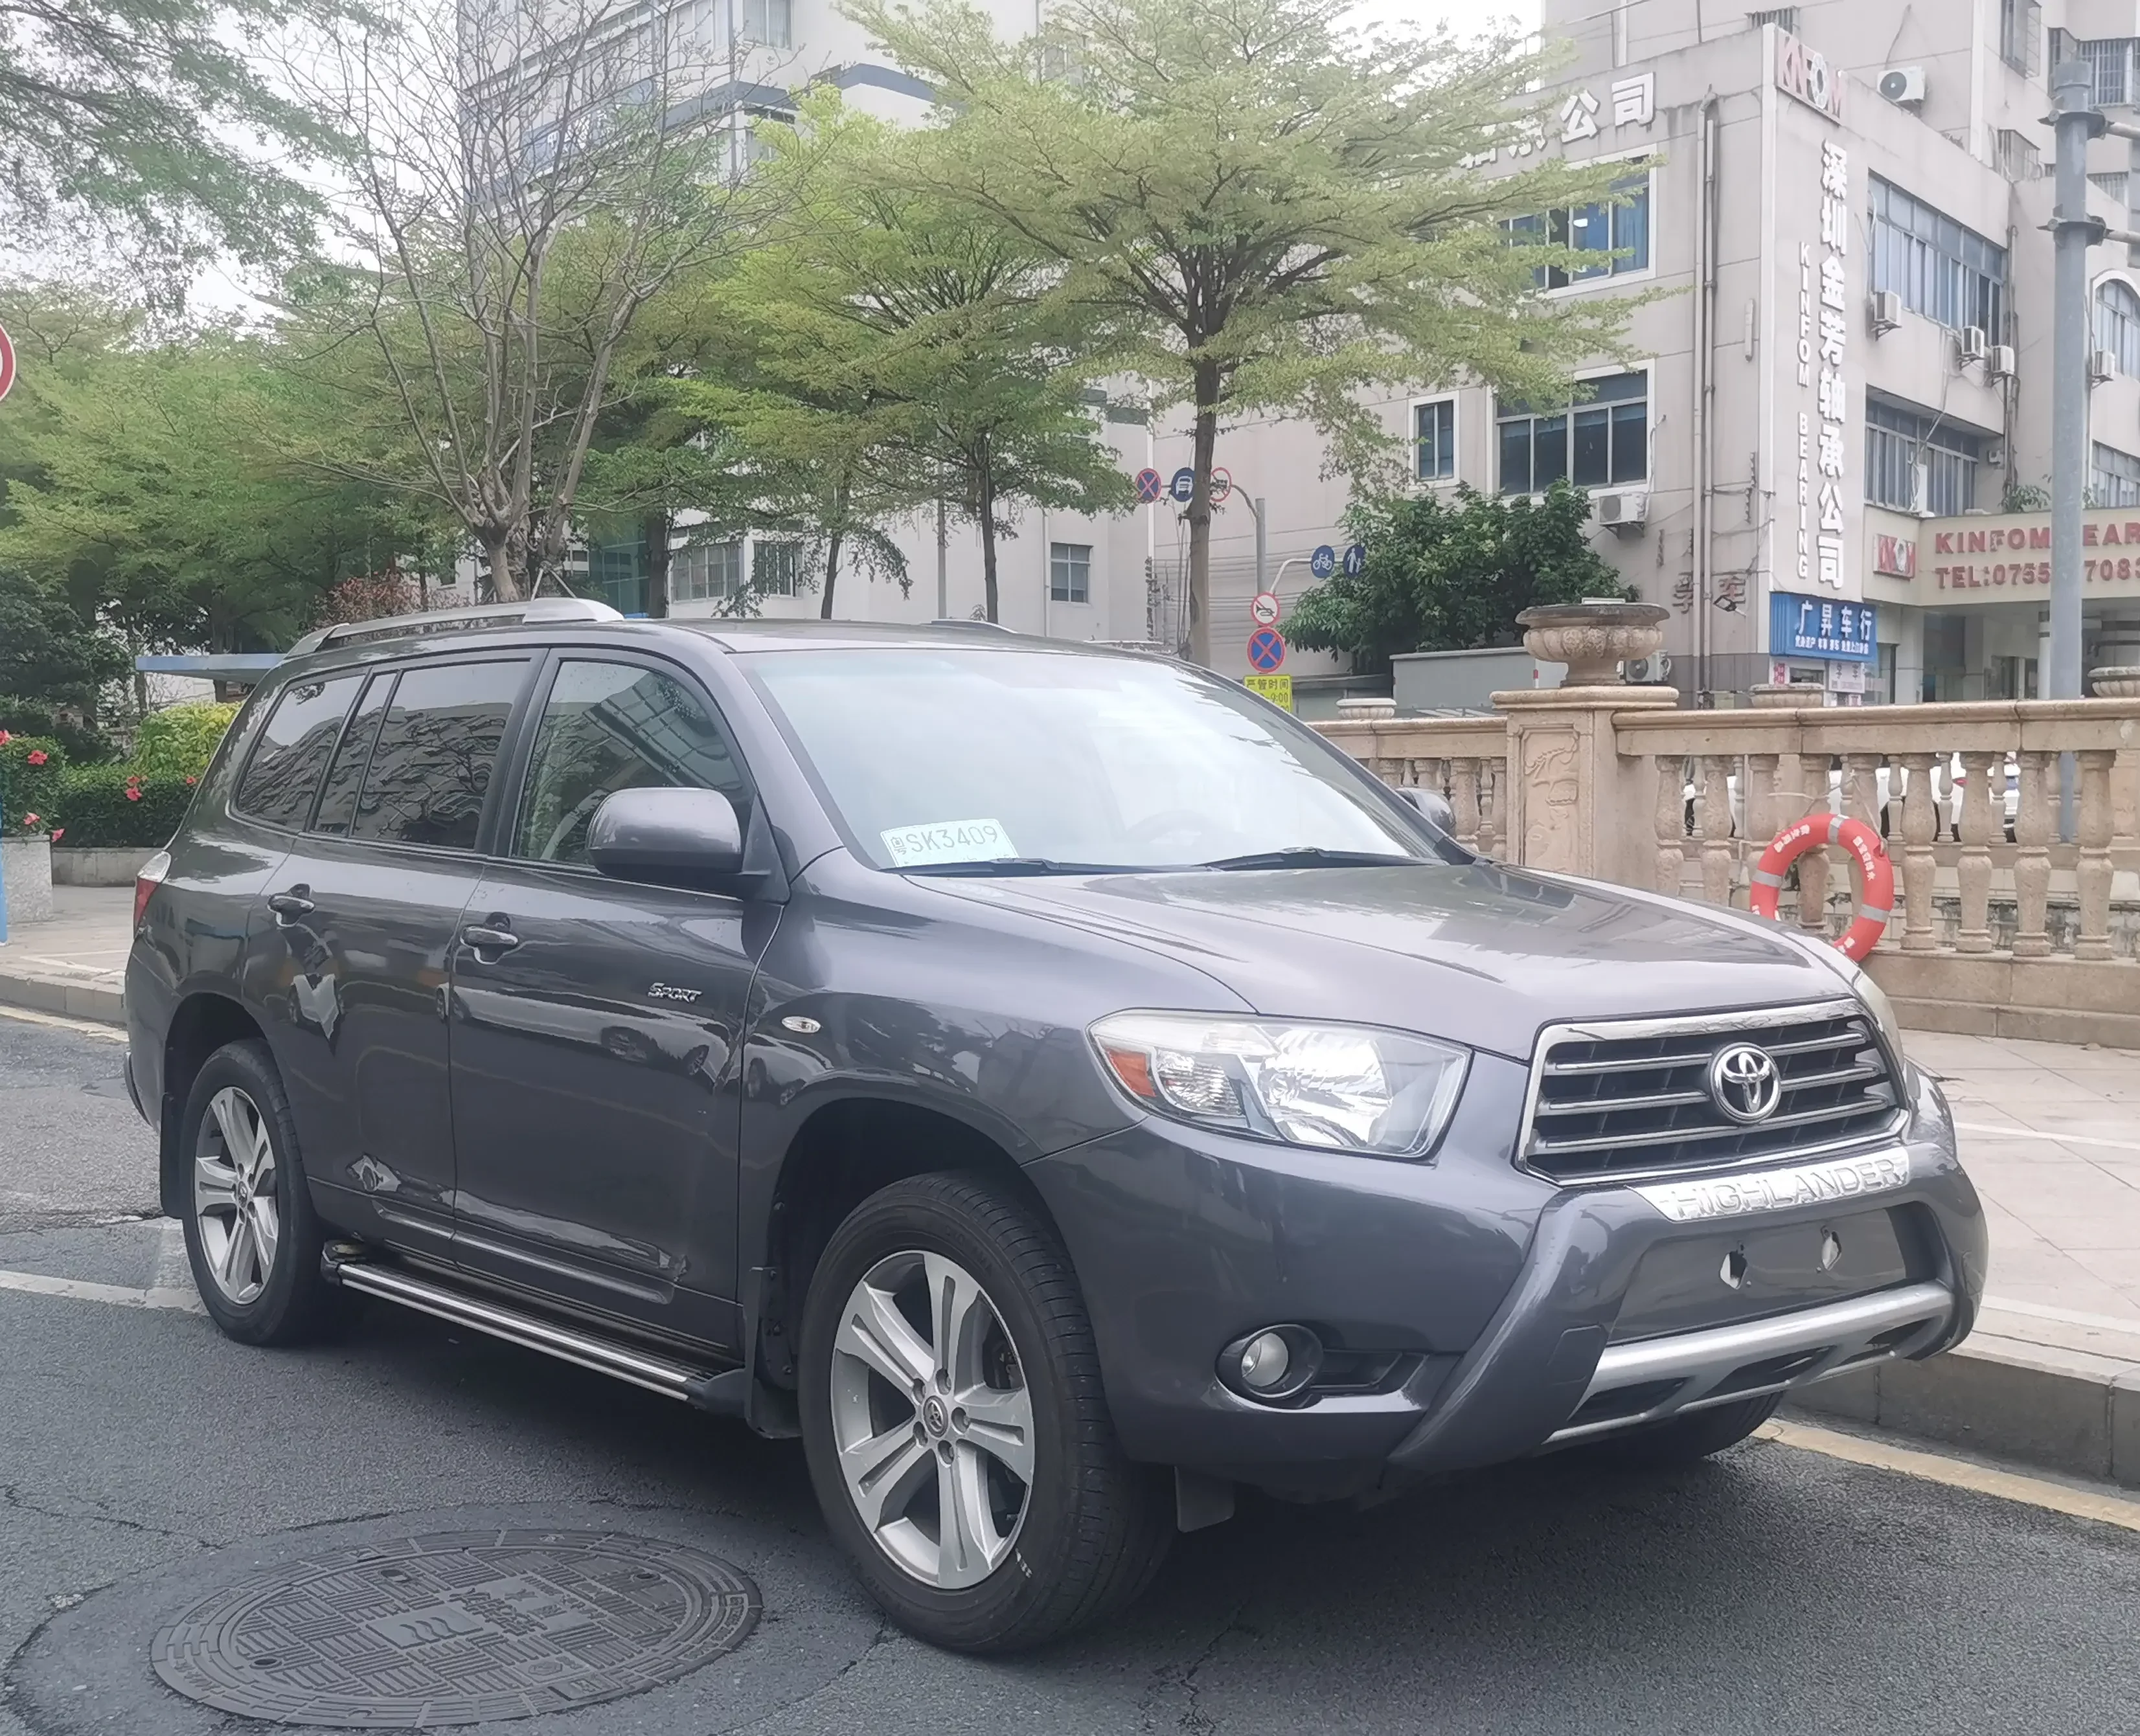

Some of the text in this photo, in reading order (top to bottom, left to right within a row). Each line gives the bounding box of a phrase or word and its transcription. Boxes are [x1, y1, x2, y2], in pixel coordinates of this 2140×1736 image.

[1817, 138, 1847, 591] 深圳金芳轴承公司
[1797, 241, 1811, 580] KINFOM BEARING
[1935, 521, 2140, 554] KINFOM EAR
[890, 825, 998, 855] 粤SK3409
[1667, 1158, 1904, 1219] HIGHLANDER
